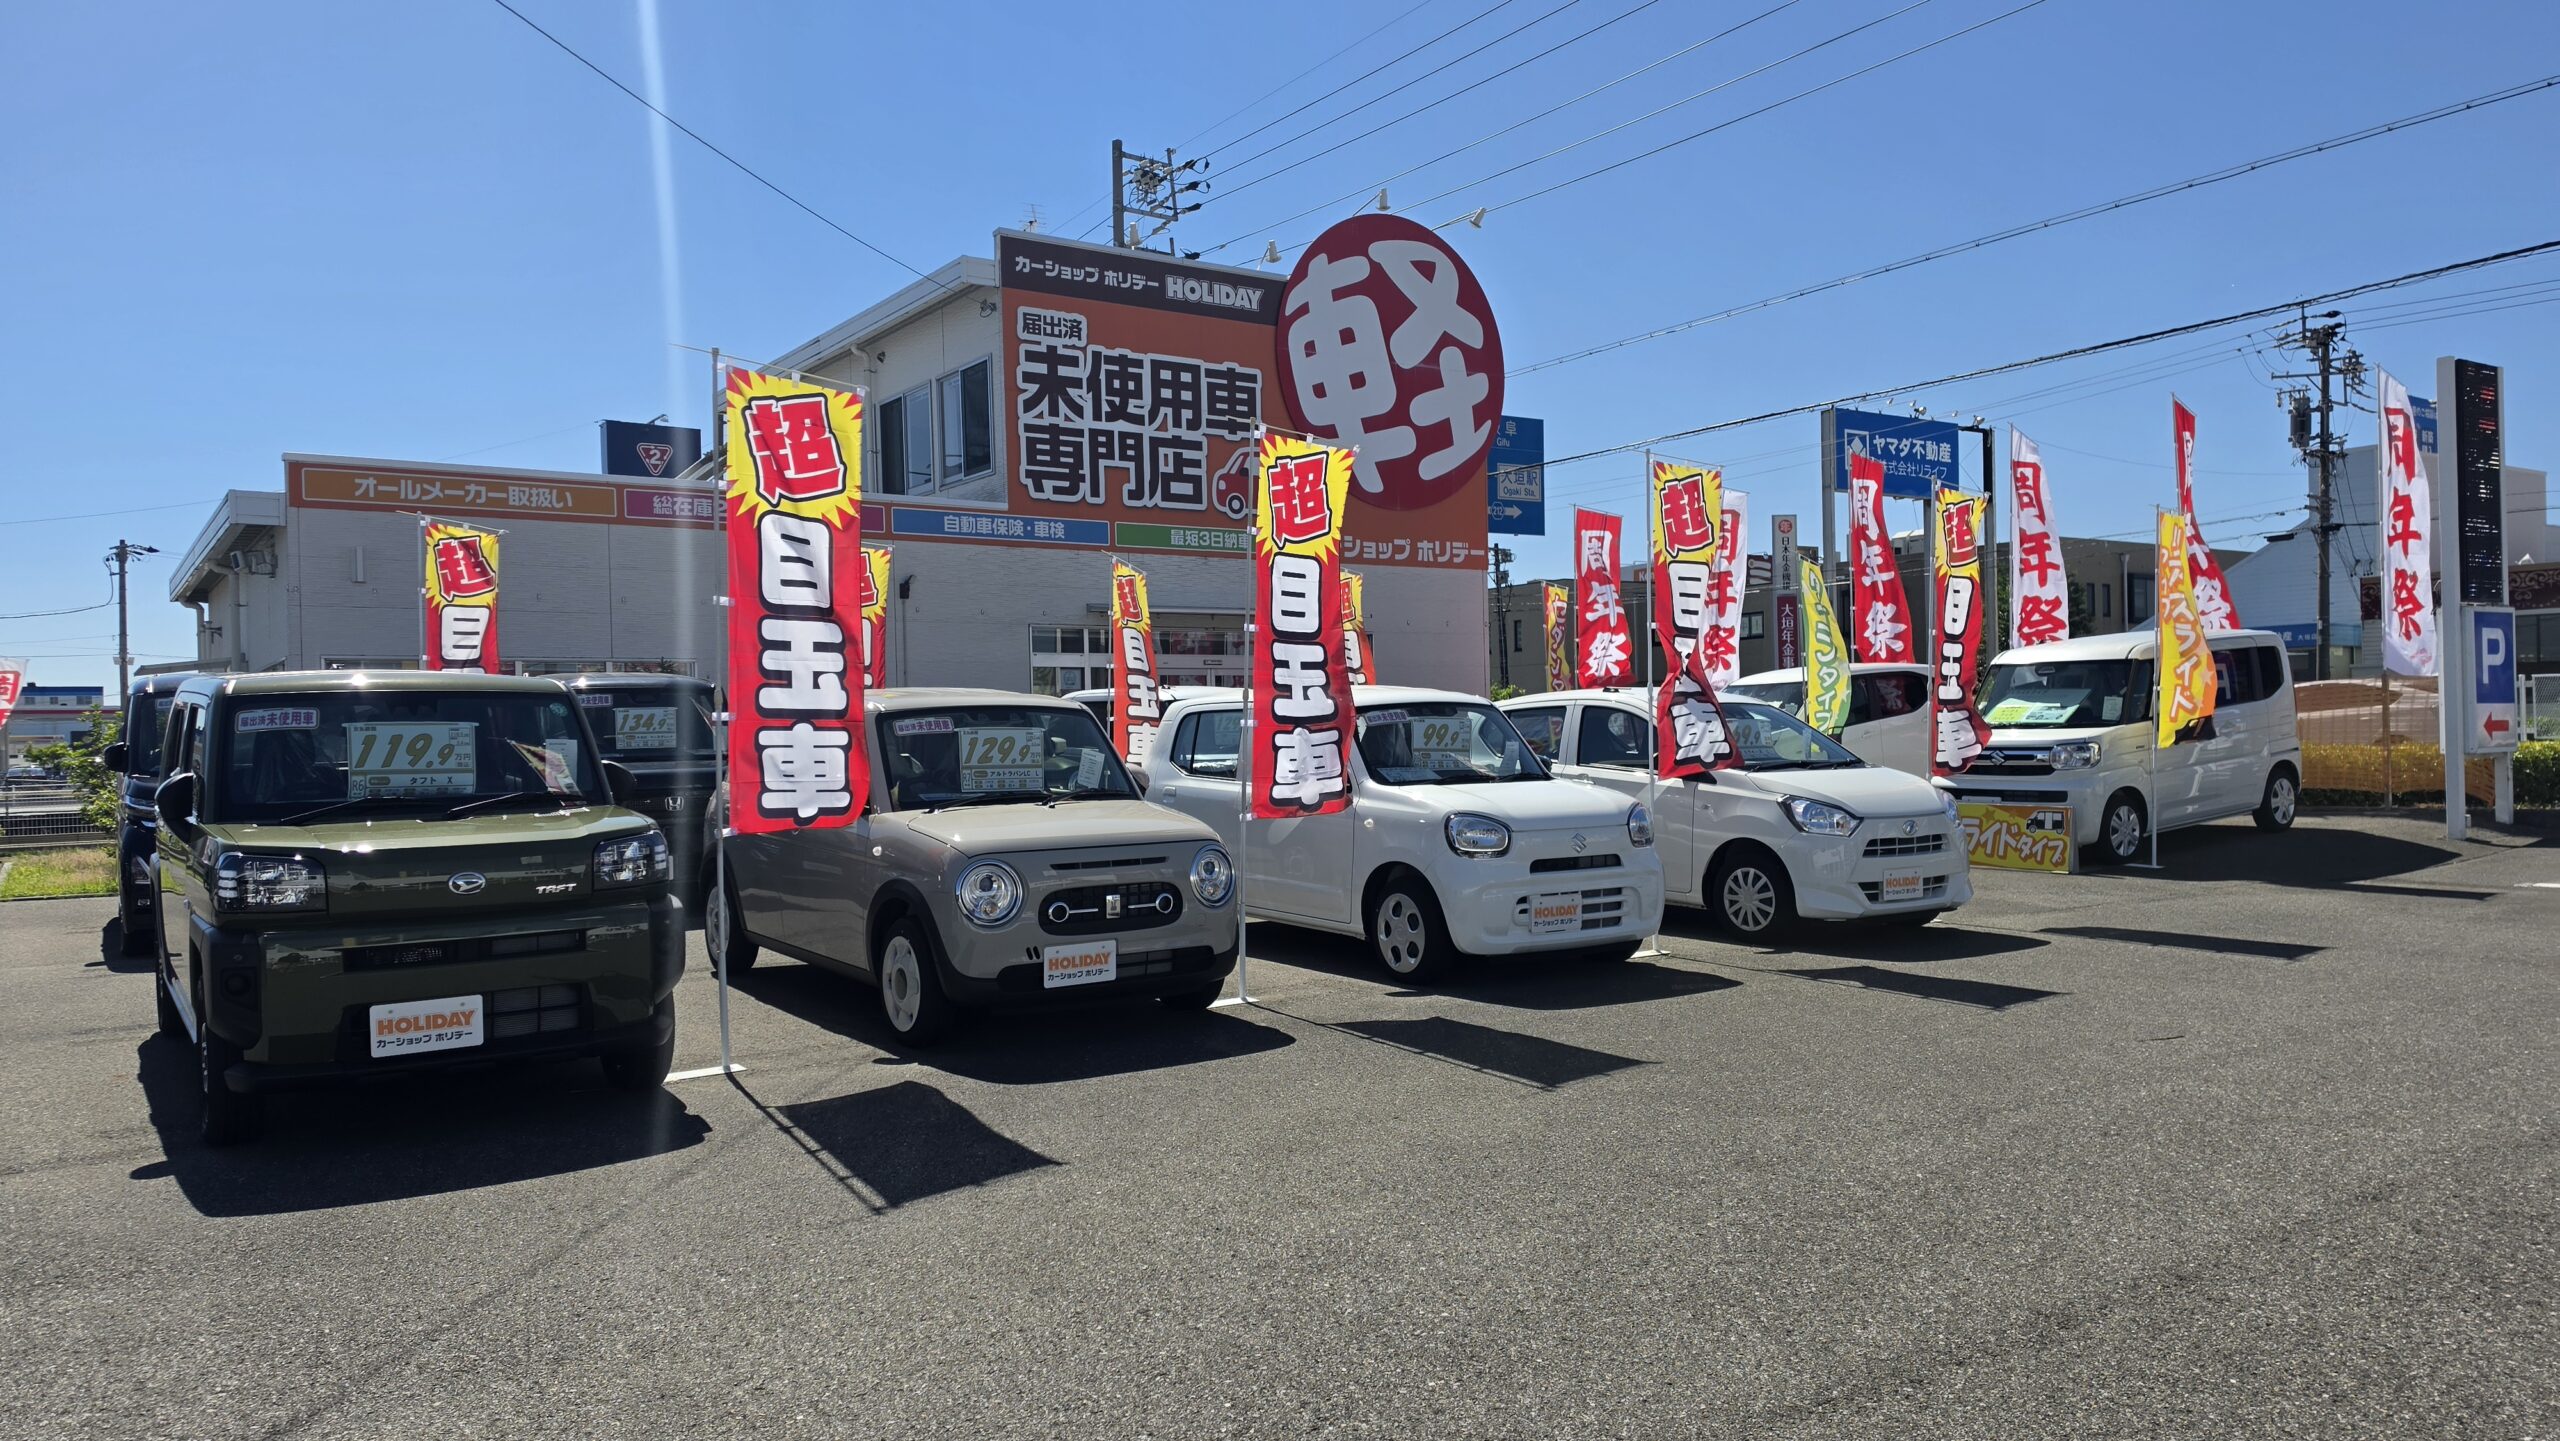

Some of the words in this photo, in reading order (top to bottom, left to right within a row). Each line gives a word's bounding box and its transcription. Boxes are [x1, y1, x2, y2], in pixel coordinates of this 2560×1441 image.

[1015, 255, 1099, 283] カーショップ
[1104, 269, 1159, 291] ホリデー
[1165, 274, 1264, 311] HOLIDAY
[1021, 311, 1083, 341] 届出済
[1285, 239, 1492, 493] 軽
[1021, 344, 1259, 436] 未使用車
[1497, 420, 1517, 437] 阜
[1873, 434, 1951, 463] ヤマダ不動産
[1023, 424, 1207, 505] 専門店
[354, 476, 573, 508] オールメーカー取扱い
[1503, 486, 1522, 497] Ogaki
[1524, 487, 1537, 497] Sta.
[943, 515, 1065, 540] 自動車保険・車検
[2384, 407, 2425, 643] 周年祭
[1341, 536, 1411, 560] ショップ
[1417, 540, 1485, 563] ホリデー
[1581, 529, 1628, 677] 周年祭
[2481, 627, 2506, 685] P
[619, 712, 667, 741] 134.9
[1423, 723, 1459, 748] 99.9
[354, 733, 455, 768] 119.9
[964, 736, 1030, 764] 129.9
[409, 776, 437, 785] タフト
[446, 775, 454, 785] X
[535, 883, 578, 895] TAFT
[1534, 904, 1578, 918] HOLIDAY
[1048, 951, 1111, 971] HOLIDAY
[1048, 970, 1083, 981] カーショップ
[1085, 968, 1110, 977] ホリデー
[376, 1008, 478, 1036] HOLIDAY
[376, 1034, 432, 1049] カーショップ
[435, 1030, 473, 1041] ホリデー
